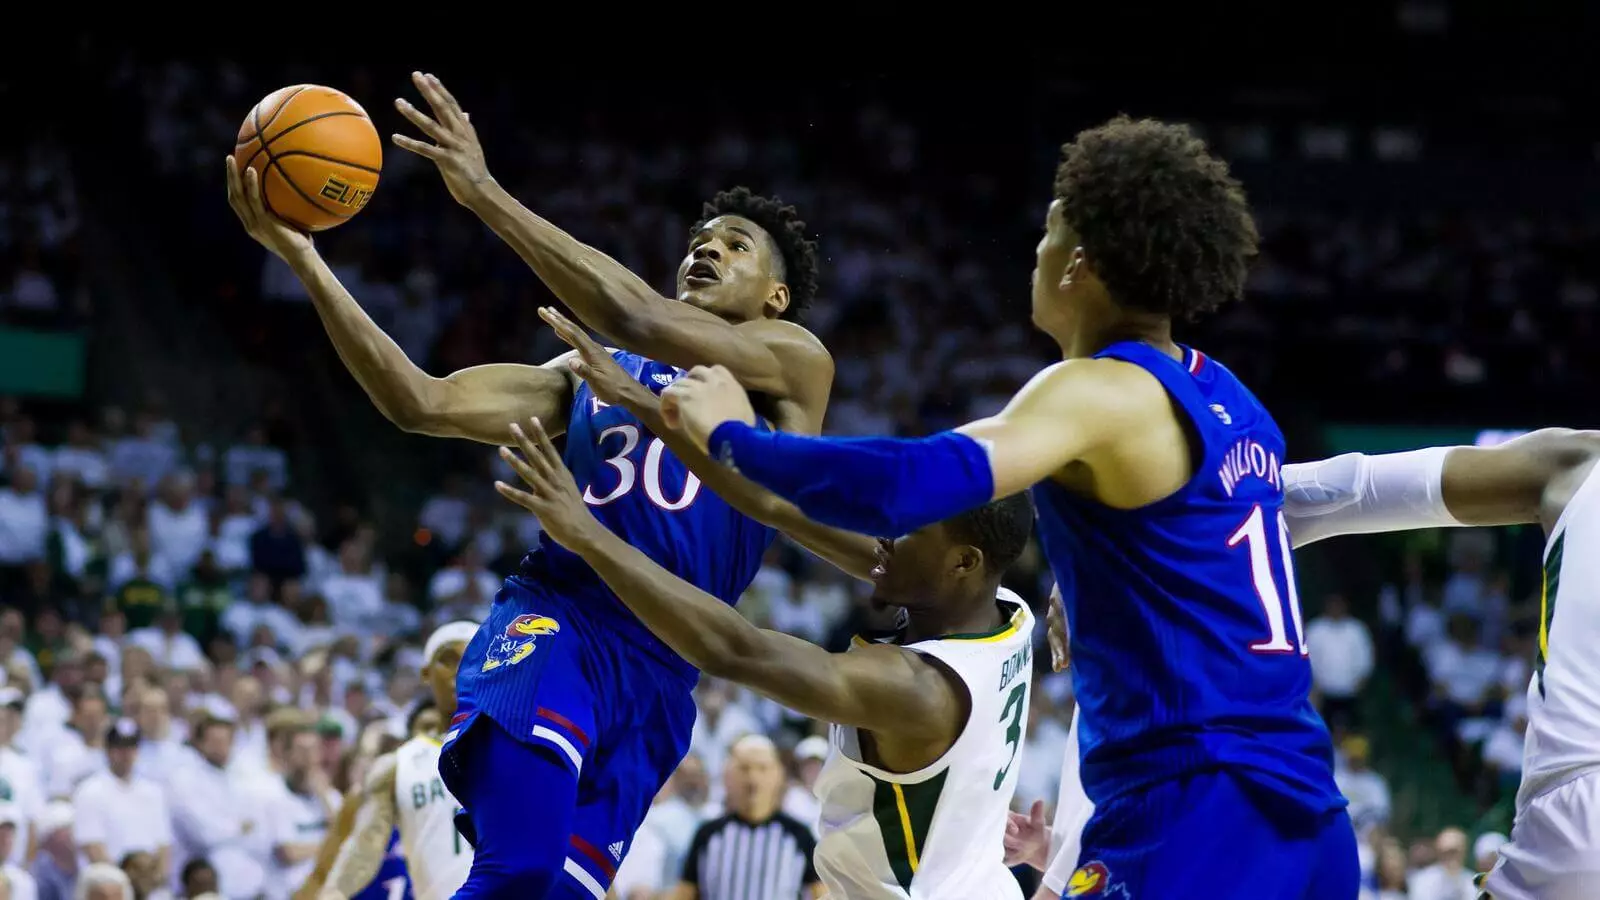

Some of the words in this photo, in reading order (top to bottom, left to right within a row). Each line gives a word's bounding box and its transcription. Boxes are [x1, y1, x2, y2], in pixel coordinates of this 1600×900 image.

[582, 424, 702, 511] 30
[500, 640, 518, 653] KU
[993, 682, 1026, 791] 3
